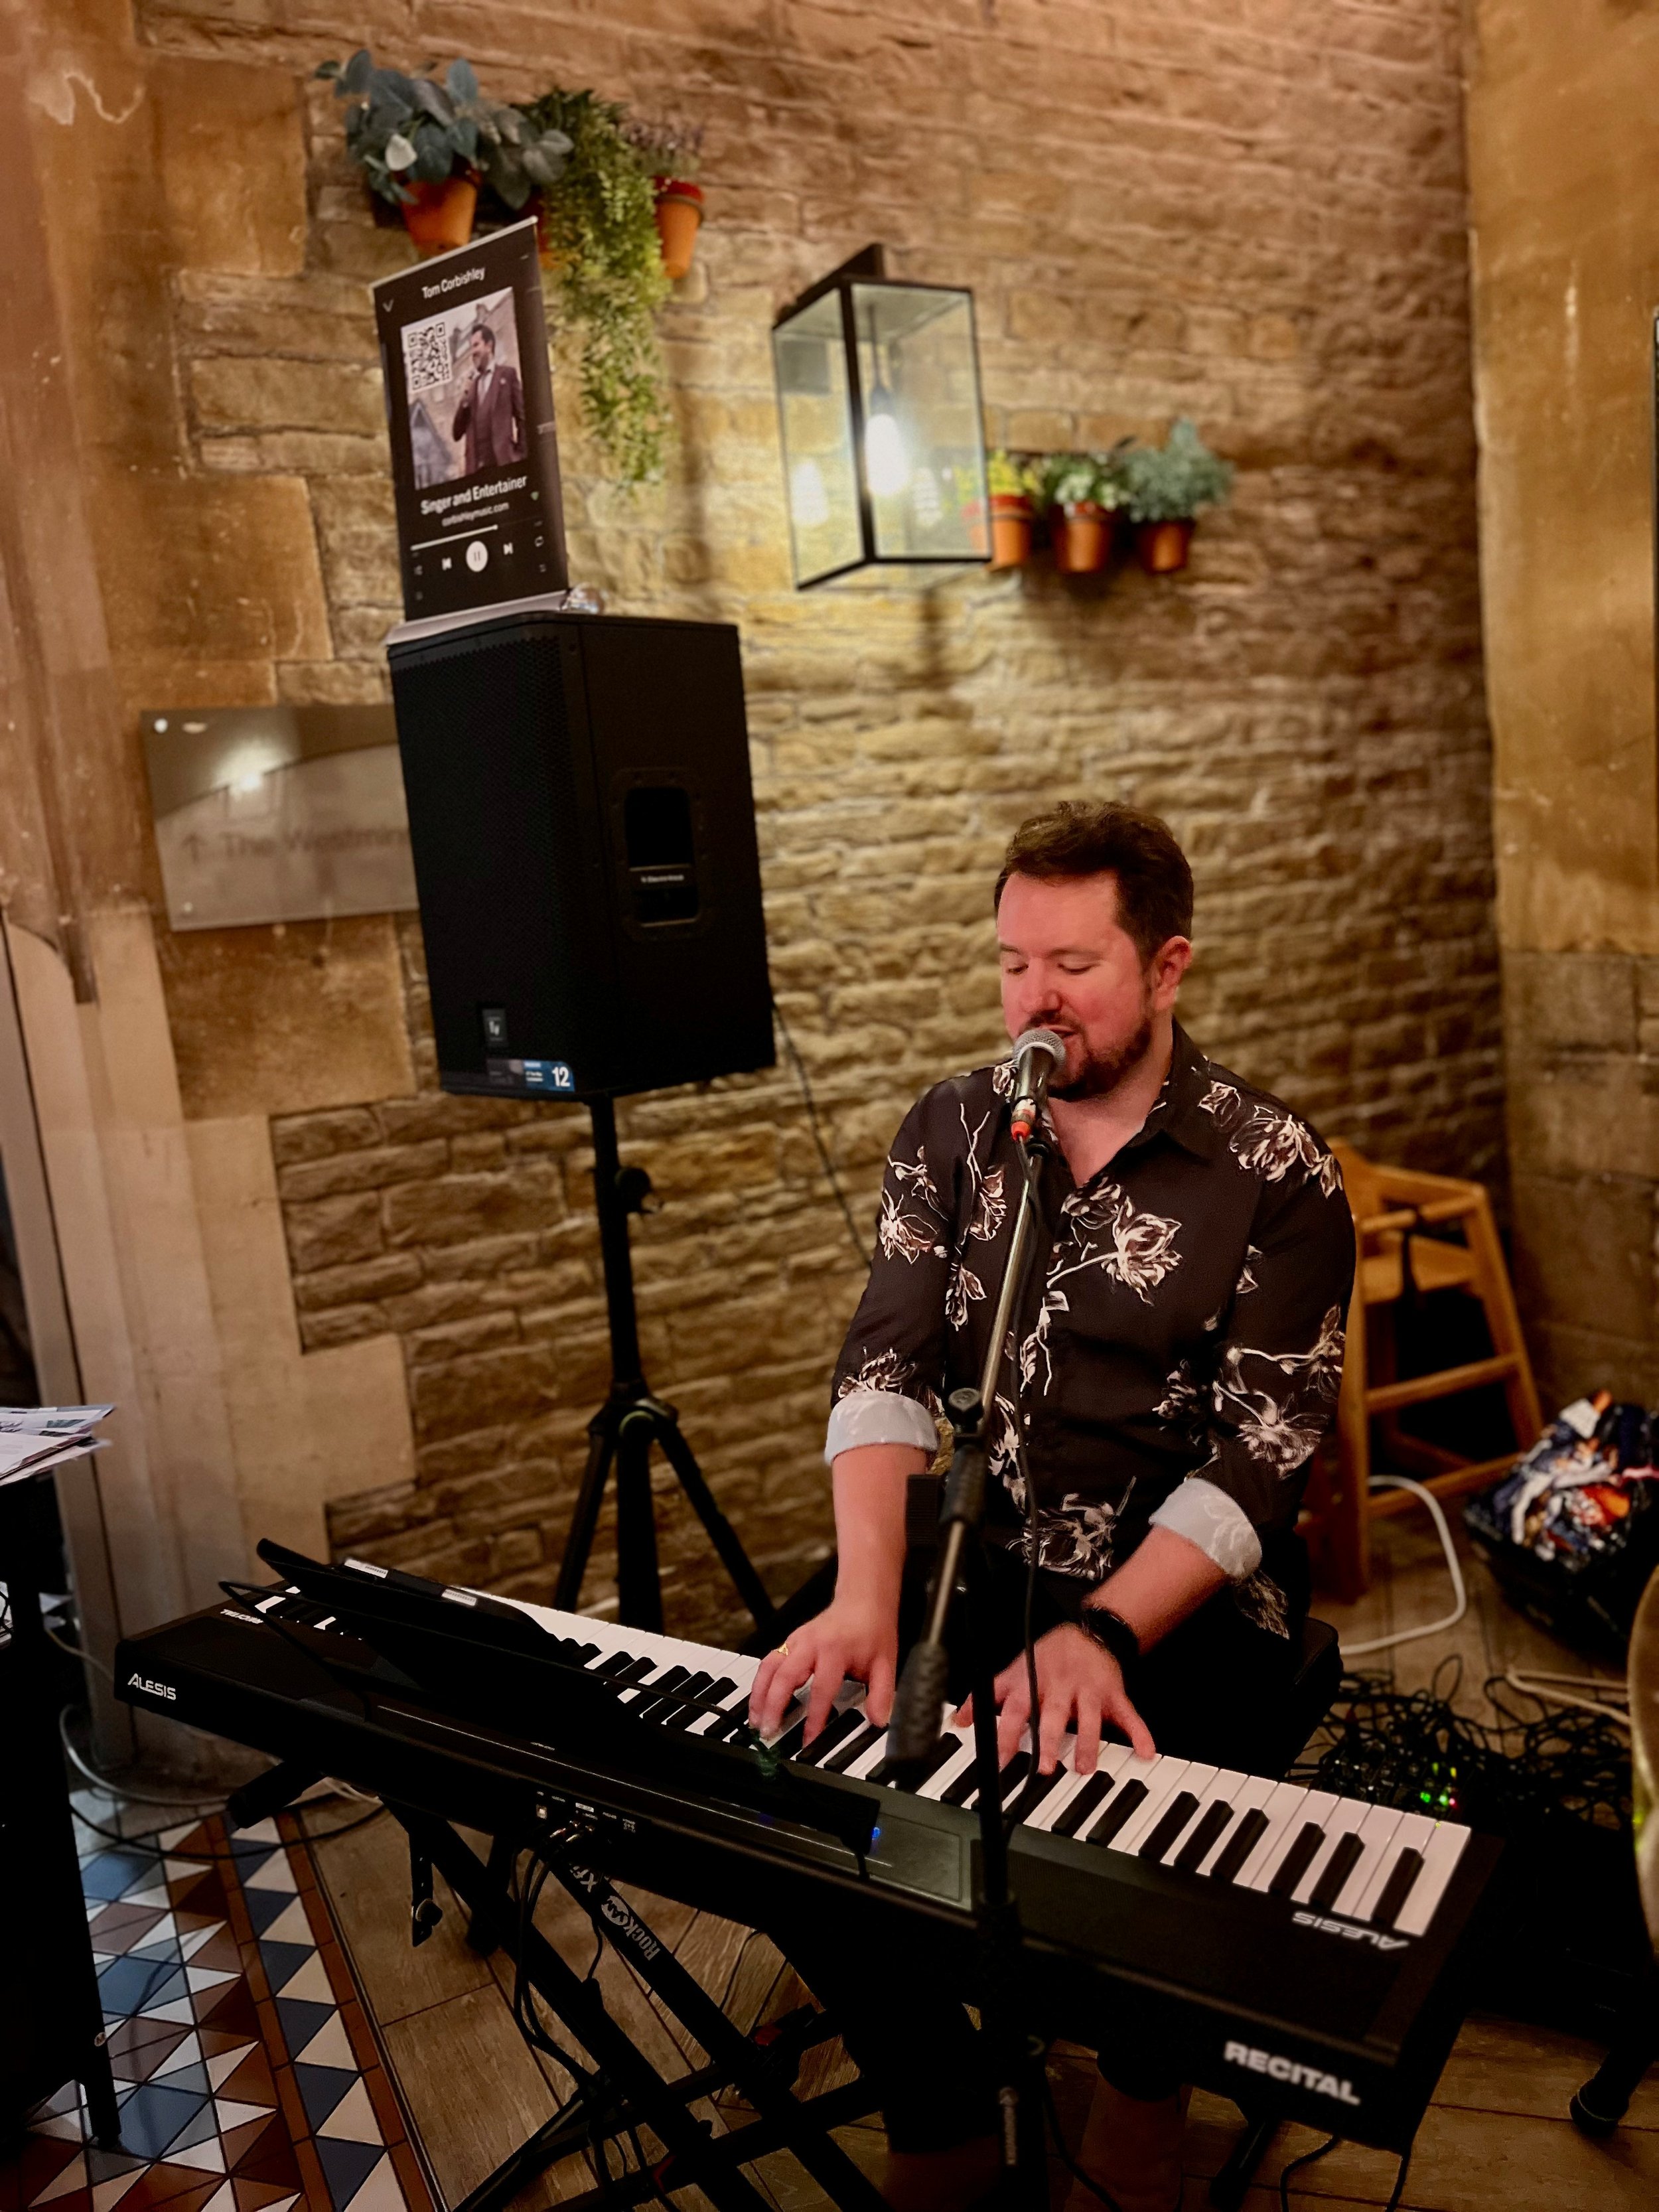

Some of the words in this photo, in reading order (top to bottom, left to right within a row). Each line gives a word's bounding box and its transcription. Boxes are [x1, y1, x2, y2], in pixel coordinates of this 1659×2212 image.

[421, 285, 440, 299] Tom
[441, 267, 485, 293] Corbishley
[421, 497, 452, 515] Singer
[453, 488, 472, 506] and
[472, 475, 527, 500] Entertainer
[551, 1067, 571, 1087] 12
[127, 1673, 177, 1700] ALESIS
[569, 1863, 598, 1893] Xfi
[1291, 1911, 1409, 1951] ALESIS
[1224, 2040, 1361, 2106] RECITAL
